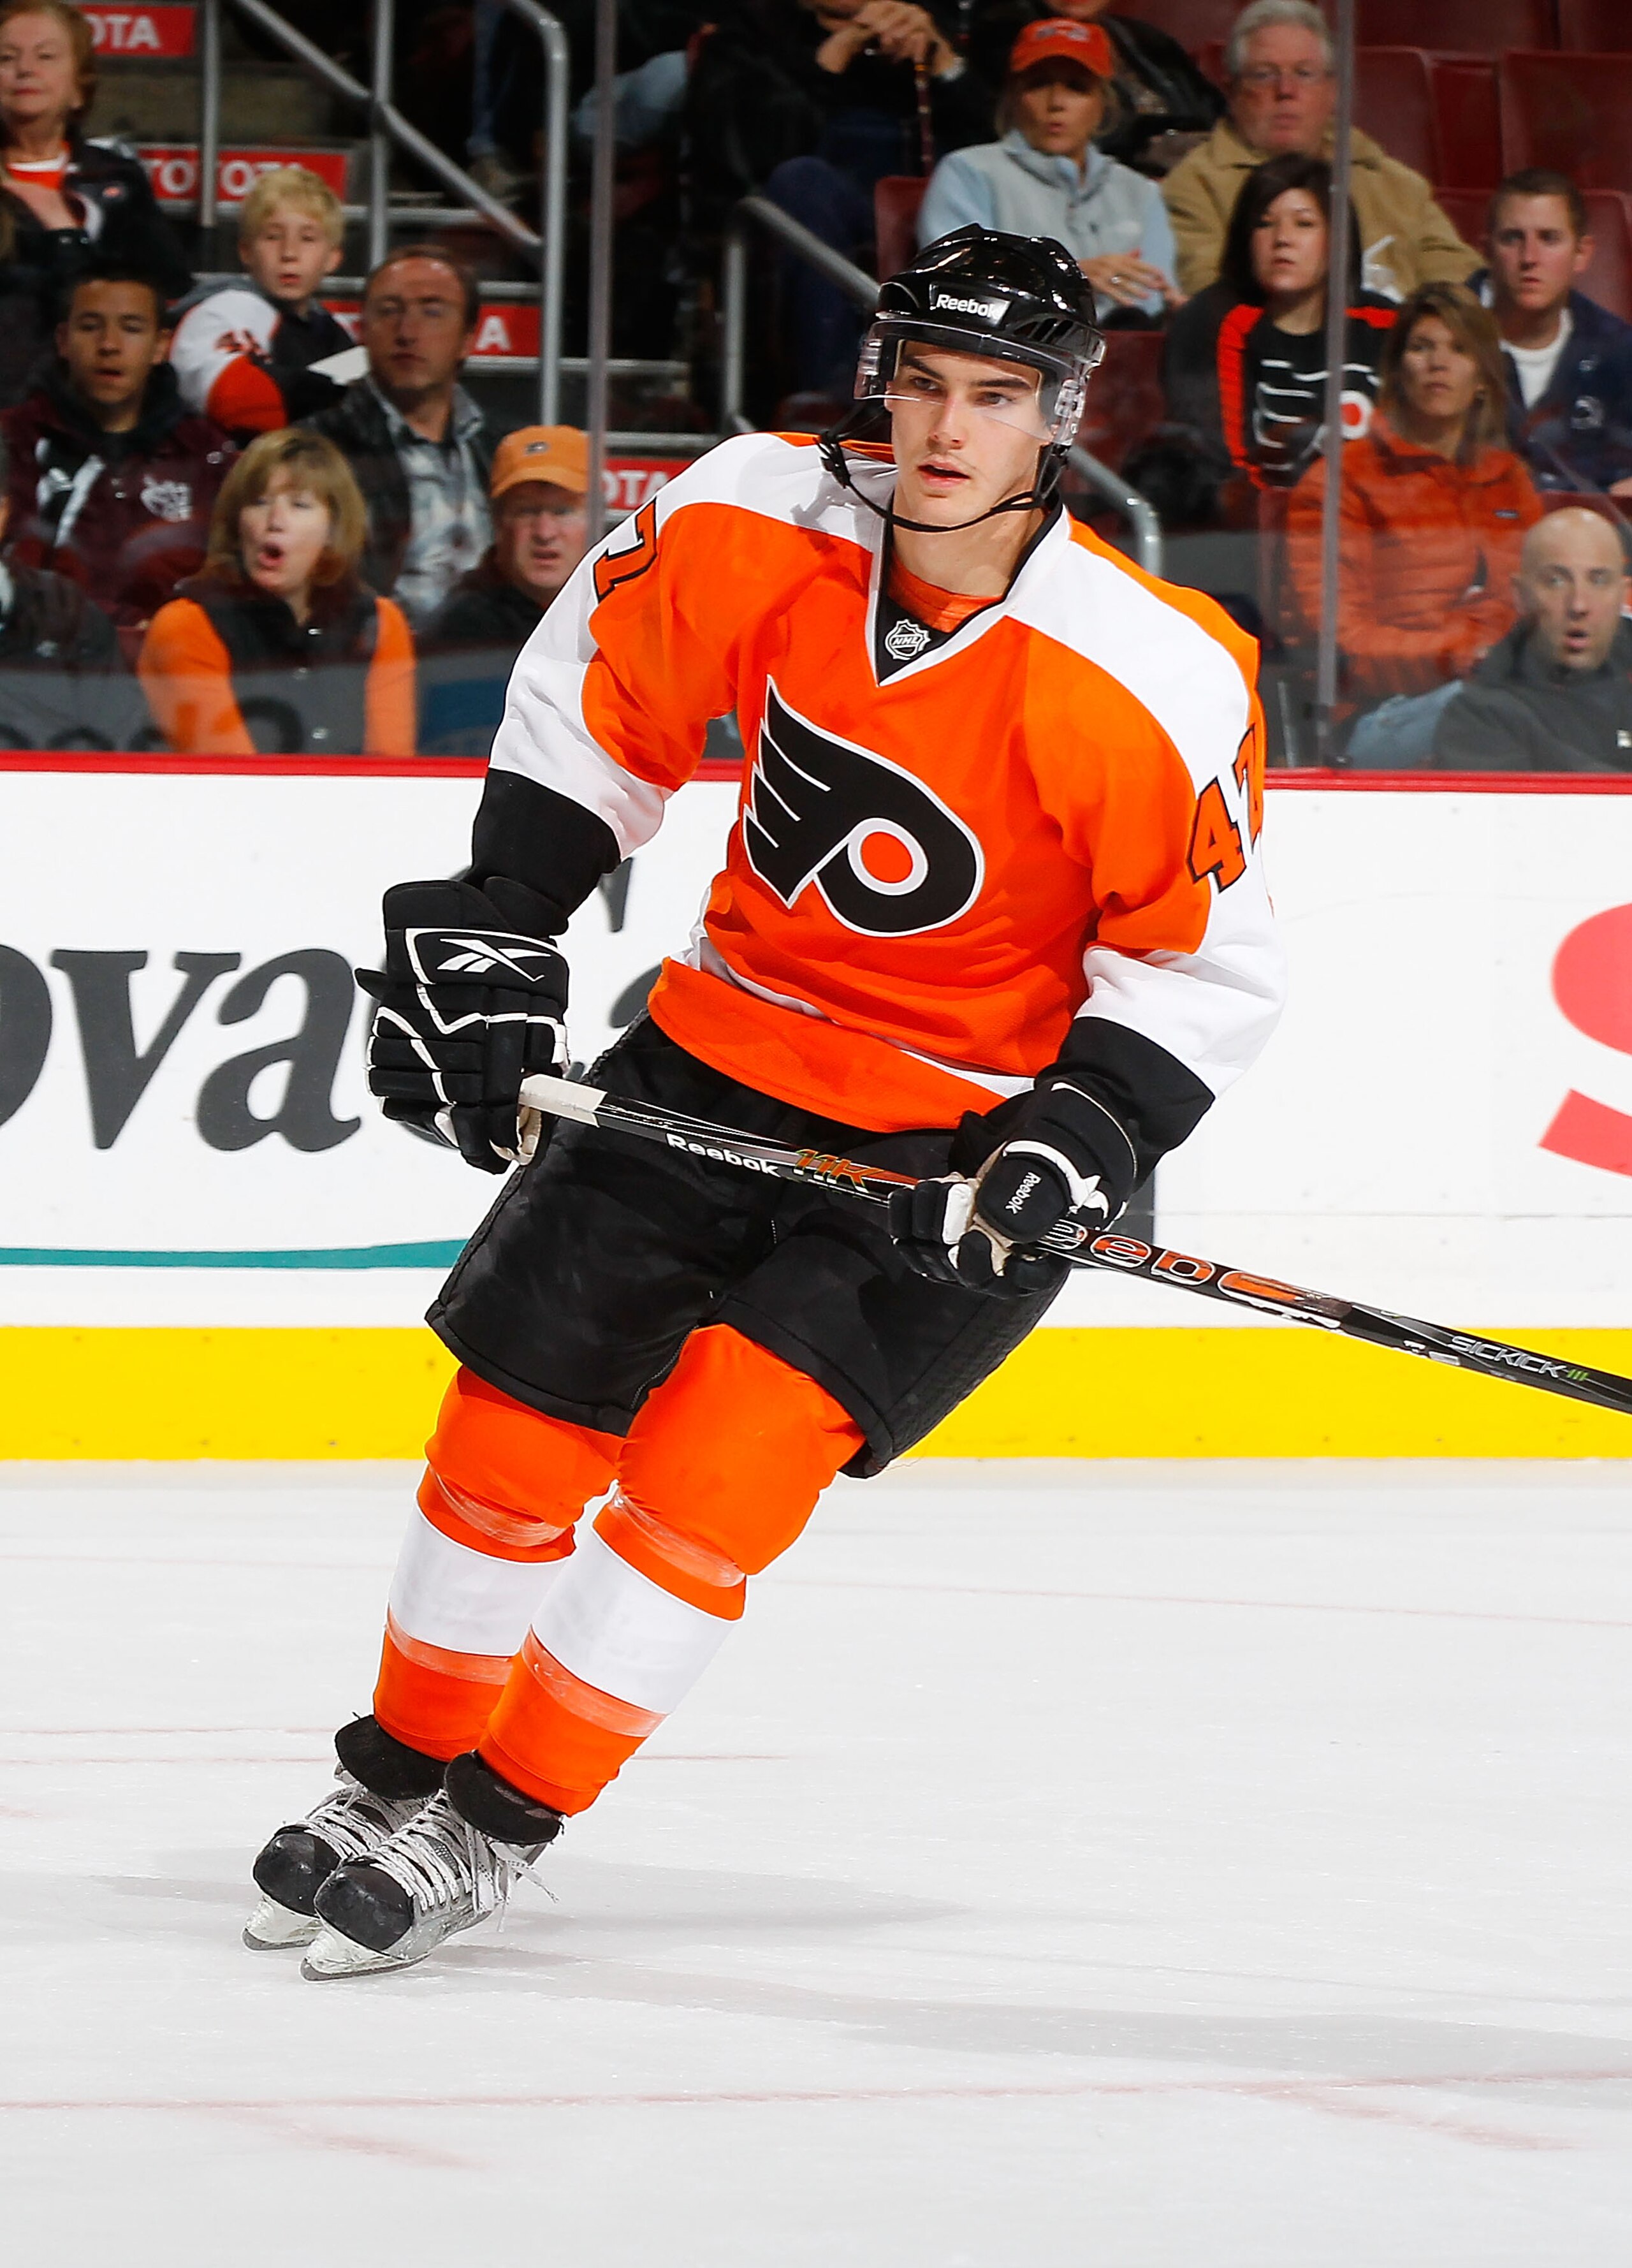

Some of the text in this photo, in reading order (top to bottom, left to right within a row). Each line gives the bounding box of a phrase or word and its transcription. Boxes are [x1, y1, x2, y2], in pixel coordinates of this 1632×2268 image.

[936, 294, 1002, 321] Reebok
[892, 635, 918, 646] NHL
[666, 1132, 782, 1178] Reebok
[1005, 1172, 1042, 1214] Reebok
[1448, 1336, 1567, 1379] SICKICK
